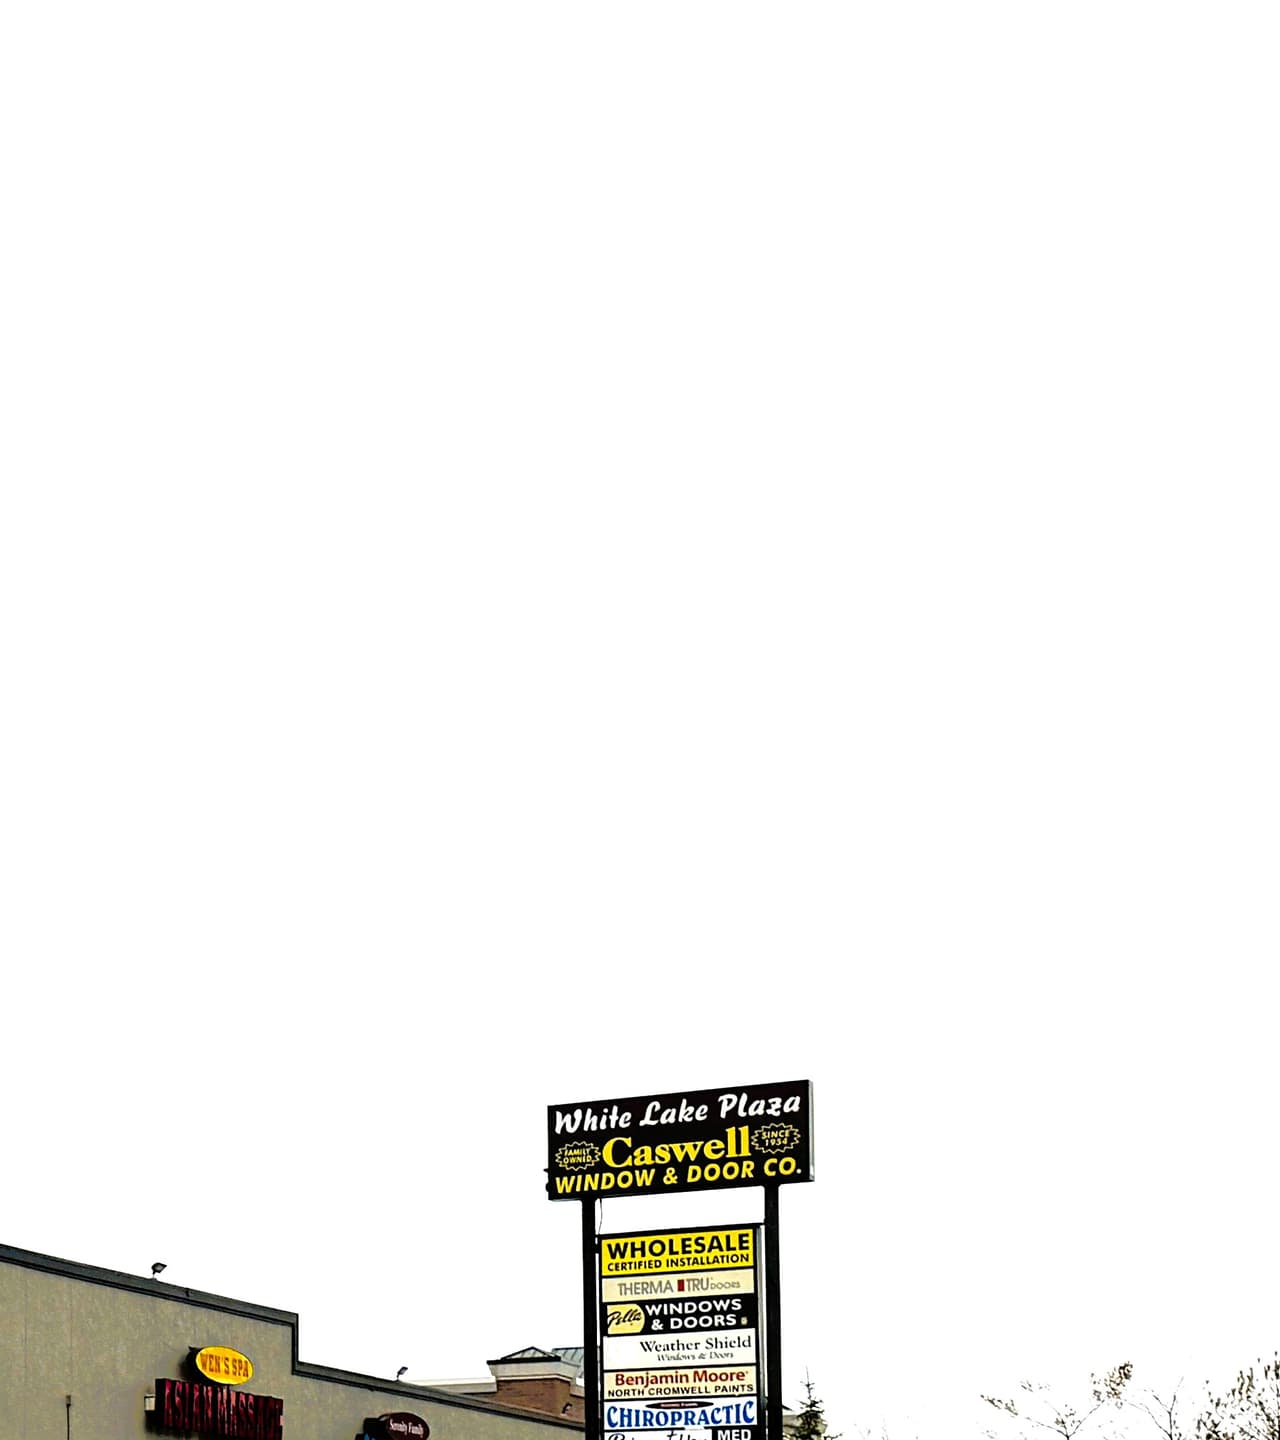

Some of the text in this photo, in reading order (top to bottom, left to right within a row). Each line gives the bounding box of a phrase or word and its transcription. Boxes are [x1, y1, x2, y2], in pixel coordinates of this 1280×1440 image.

[555, 1093, 801, 1134] White Lake Plaza
[761, 1129, 790, 1139] SINCE
[602, 1125, 751, 1168] Caswell
[563, 1155, 592, 1164] OWNED
[556, 1157, 802, 1194] WINDOW & DOOR CO.
[607, 1233, 750, 1260] WHOLESALE
[607, 1253, 750, 1272] CERTIFIED INSTALLATION
[618, 1278, 740, 1296] THERMA TRU DOORS
[645, 1299, 742, 1316] WINDOWS
[608, 1308, 641, 1329] Pella
[651, 1314, 737, 1330] & DOORS
[640, 1336, 752, 1352] Weather Shield
[657, 1352, 695, 1361] Windows
[709, 1352, 734, 1360] Doors
[232, 1358, 249, 1377] SPA
[615, 1370, 746, 1388] Benjamin Moore
[608, 1383, 754, 1397] NORTH CROMWELL PAINTS
[164, 1380, 213, 1431] ASIAN
[607, 1400, 755, 1428] CHIROPRACTIC
